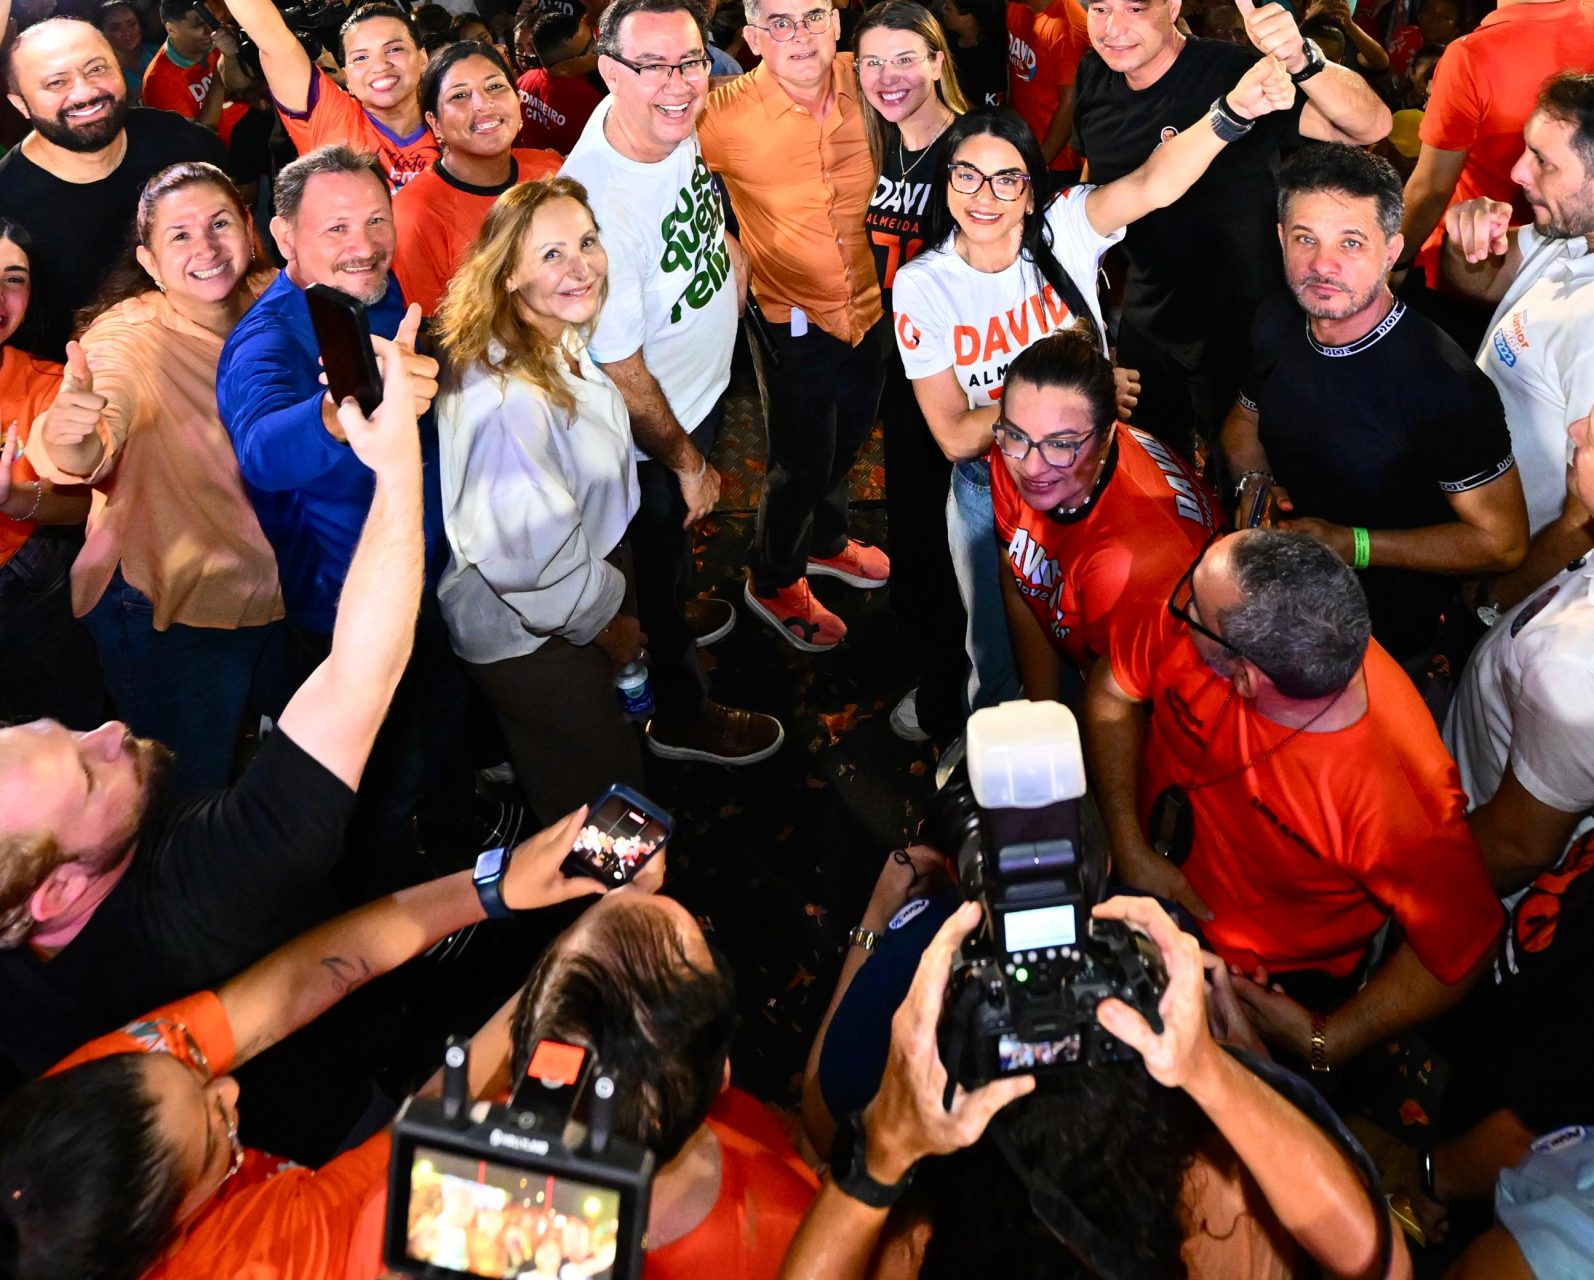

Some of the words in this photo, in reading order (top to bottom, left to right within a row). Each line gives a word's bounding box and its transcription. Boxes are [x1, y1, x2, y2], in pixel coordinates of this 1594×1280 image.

[868, 174, 932, 217] DAVI
[865, 213, 920, 234] ALMEIDA
[953, 283, 1070, 367] DAVID
[1377, 308, 1404, 337] DIOR
[1322, 346, 1352, 357] DIOR
